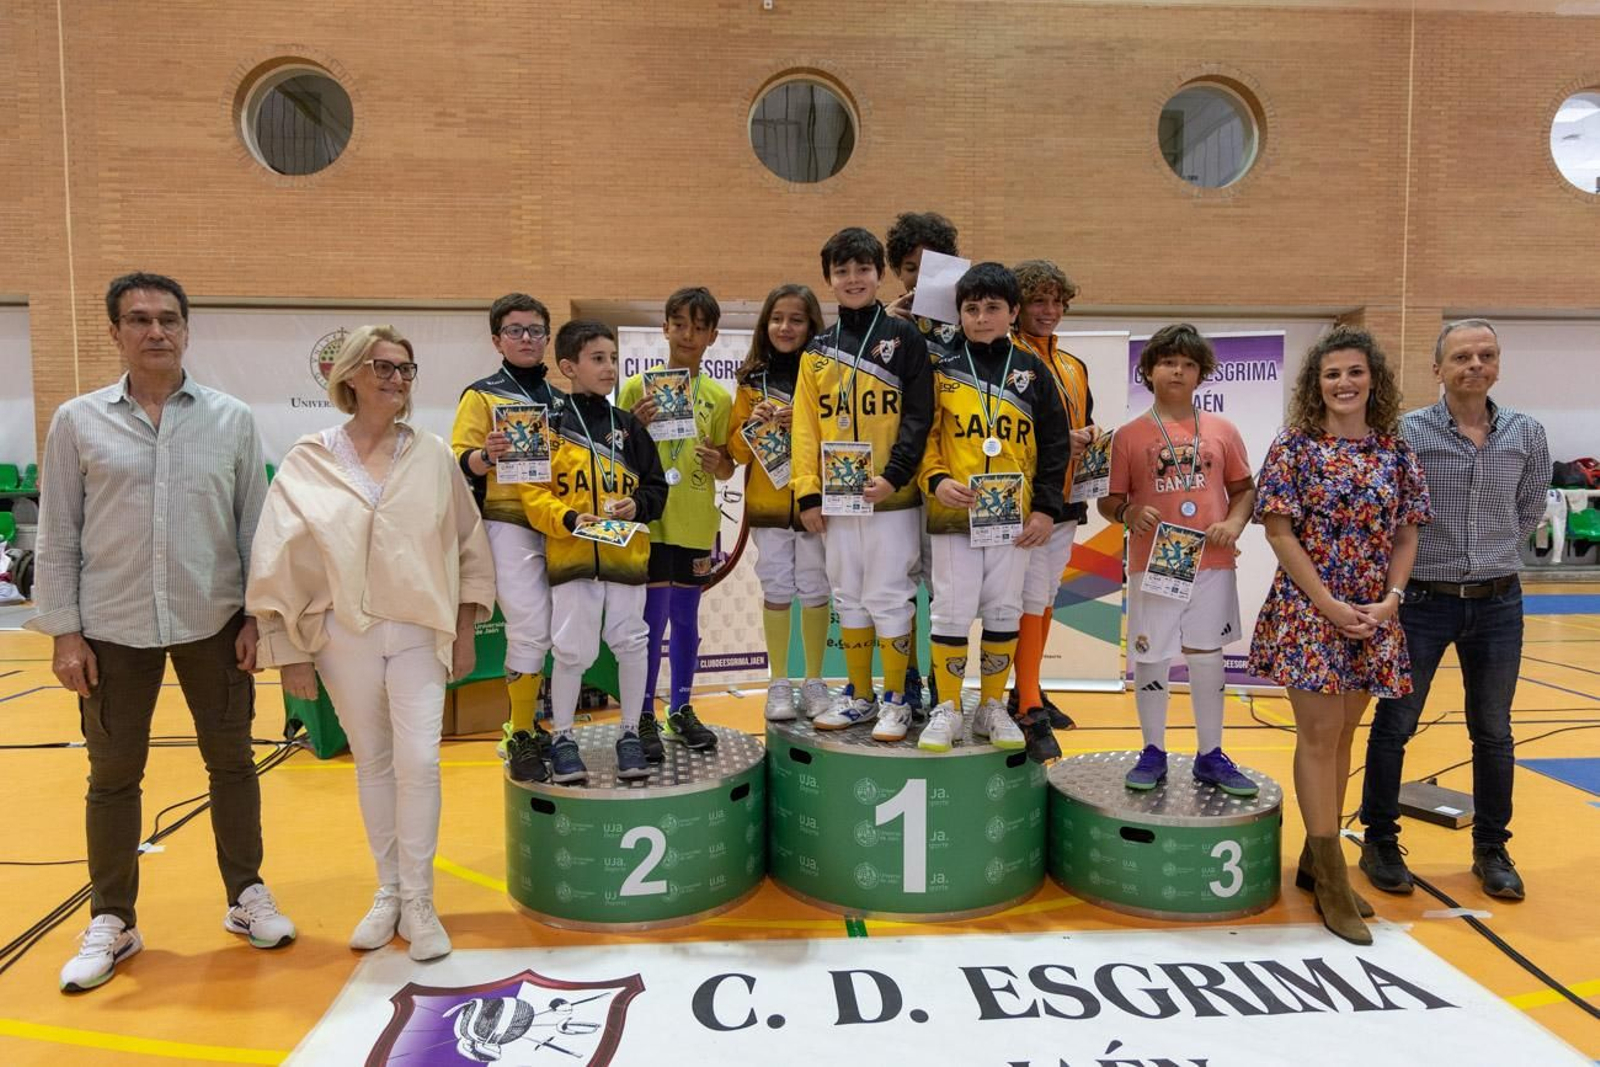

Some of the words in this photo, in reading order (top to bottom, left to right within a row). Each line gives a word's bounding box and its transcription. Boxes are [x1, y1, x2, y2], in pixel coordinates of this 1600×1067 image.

[818, 389, 898, 419] SAGR
[1193, 390, 1224, 412] AÉN
[1155, 473, 1206, 492] GAMER
[620, 826, 668, 897] 2
[876, 778, 927, 893] 1
[1209, 839, 1244, 898] 3
[691, 972, 786, 1032] C.
[828, 969, 930, 1026] D.
[957, 955, 1463, 1020] ESGRIMA
